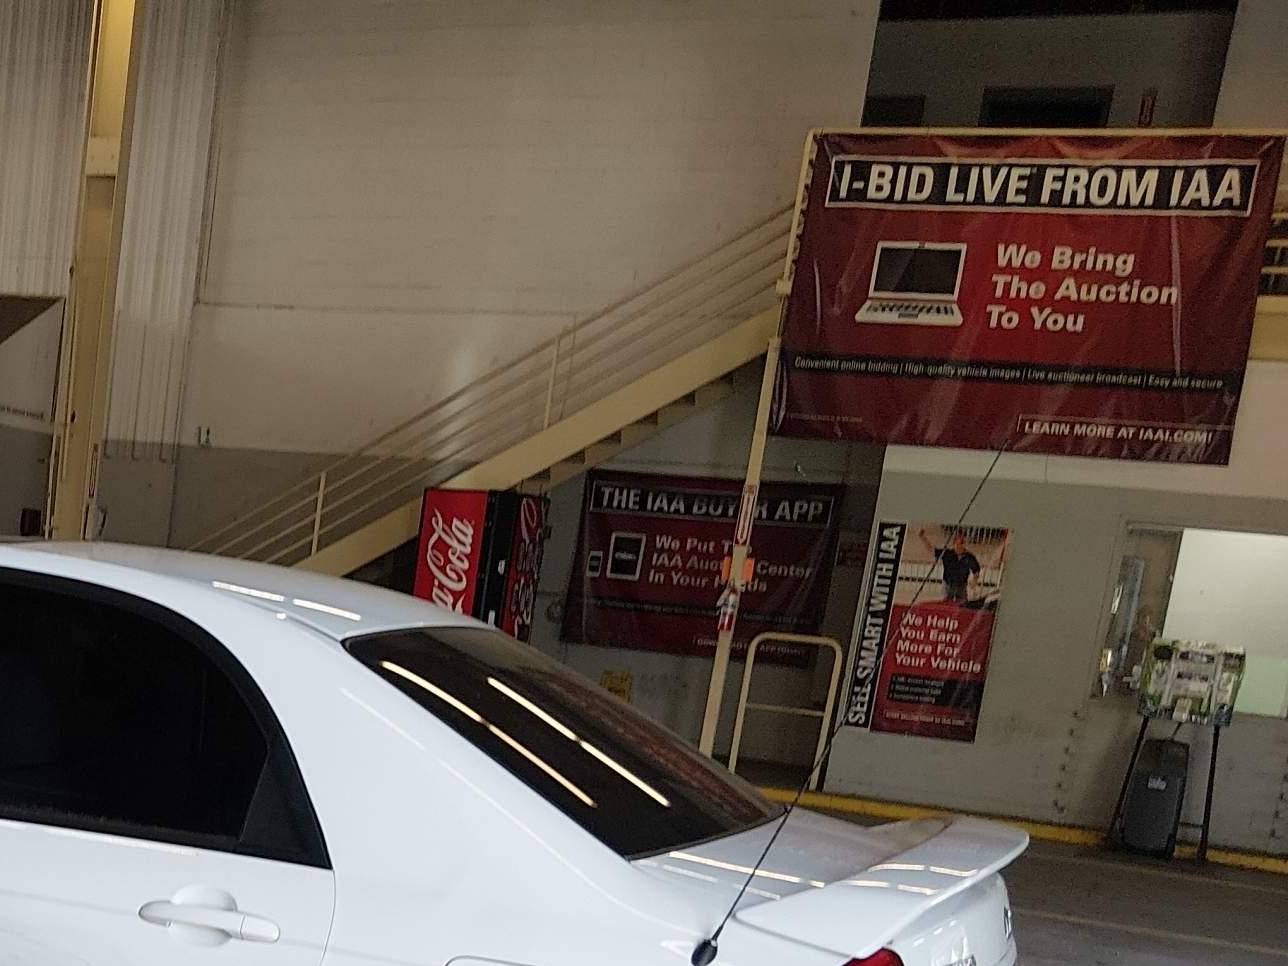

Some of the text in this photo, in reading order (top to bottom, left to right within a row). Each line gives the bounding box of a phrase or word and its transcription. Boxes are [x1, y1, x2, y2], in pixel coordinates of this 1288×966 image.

[839, 163, 1241, 207] I-BID LIVE FROM IAA
[997, 243, 1135, 277] We Bring
[991, 273, 1178, 305] The Auction
[986, 304, 1085, 333] To You
[1025, 421, 1070, 436] LEARN
[1073, 423, 1114, 438] MORE
[1117, 425, 1139, 440] AT
[601, 487, 641, 510] THE
[646, 492, 685, 515] IAA
[774, 500, 823, 521] APP
[656, 534, 681, 550] We
[686, 538, 715, 553] Put
[878, 526, 901, 559] IAA
[649, 569, 665, 584] In
[671, 571, 710, 587] Your
[652, 552, 683, 568] IAA
[756, 560, 811, 578] Center
[869, 563, 894, 611] WITH
[900, 626, 961, 644] You Earn
[927, 615, 959, 631] Help
[857, 614, 884, 679] SMART
[896, 640, 960, 658] More For
[895, 652, 981, 673] Your Vehicle
